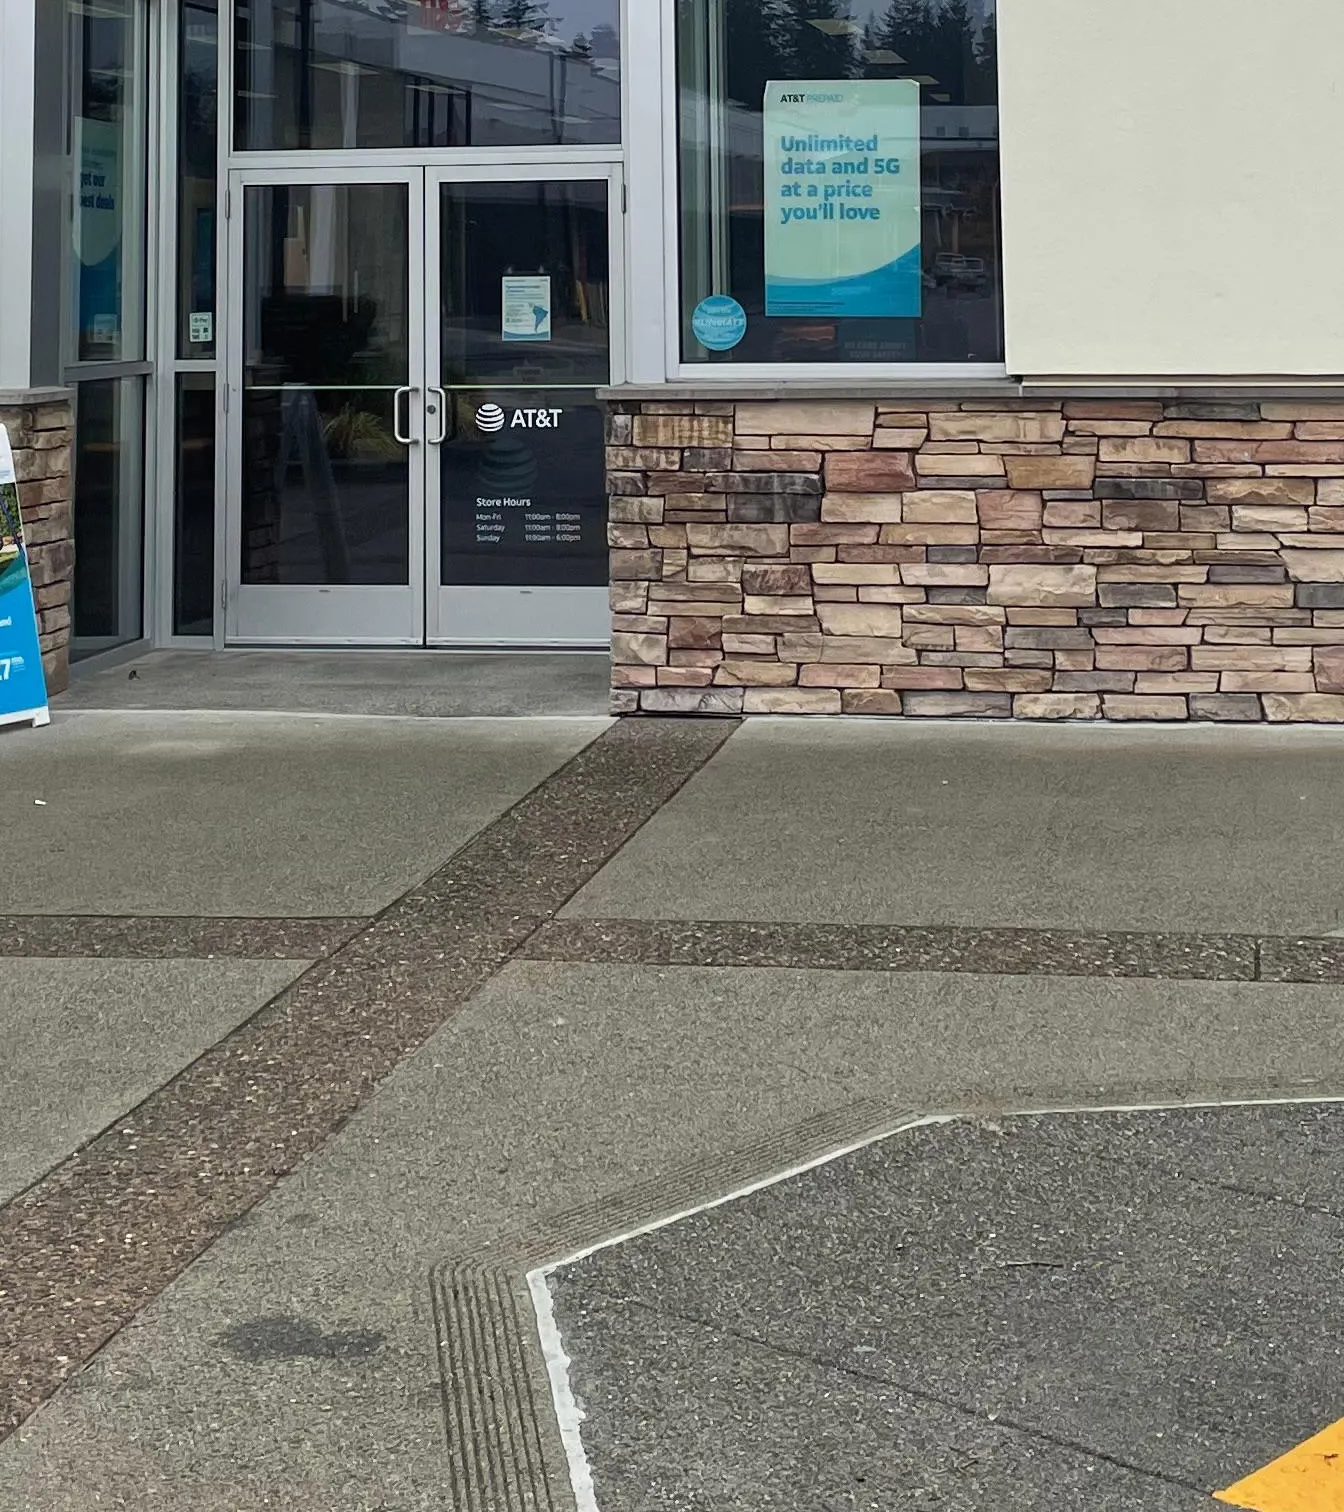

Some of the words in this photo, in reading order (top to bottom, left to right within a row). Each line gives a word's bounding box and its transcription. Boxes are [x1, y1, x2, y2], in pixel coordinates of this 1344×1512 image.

[780, 94, 805, 103] AT&T
[781, 134, 878, 152] Unlimited
[781, 157, 826, 175] data
[832, 157, 868, 175] and
[874, 158, 900, 174] 5G
[781, 182, 802, 197] at
[807, 184, 818, 197] a
[824, 179, 873, 201] price
[781, 203, 834, 224] you'll
[840, 203, 880, 220] love
[510, 409, 563, 428] AT&T
[476, 497, 502, 507] Store
[503, 497, 531, 507] Hours
[476, 524, 505, 533] Saturday
[476, 535, 500, 544] Sunday
